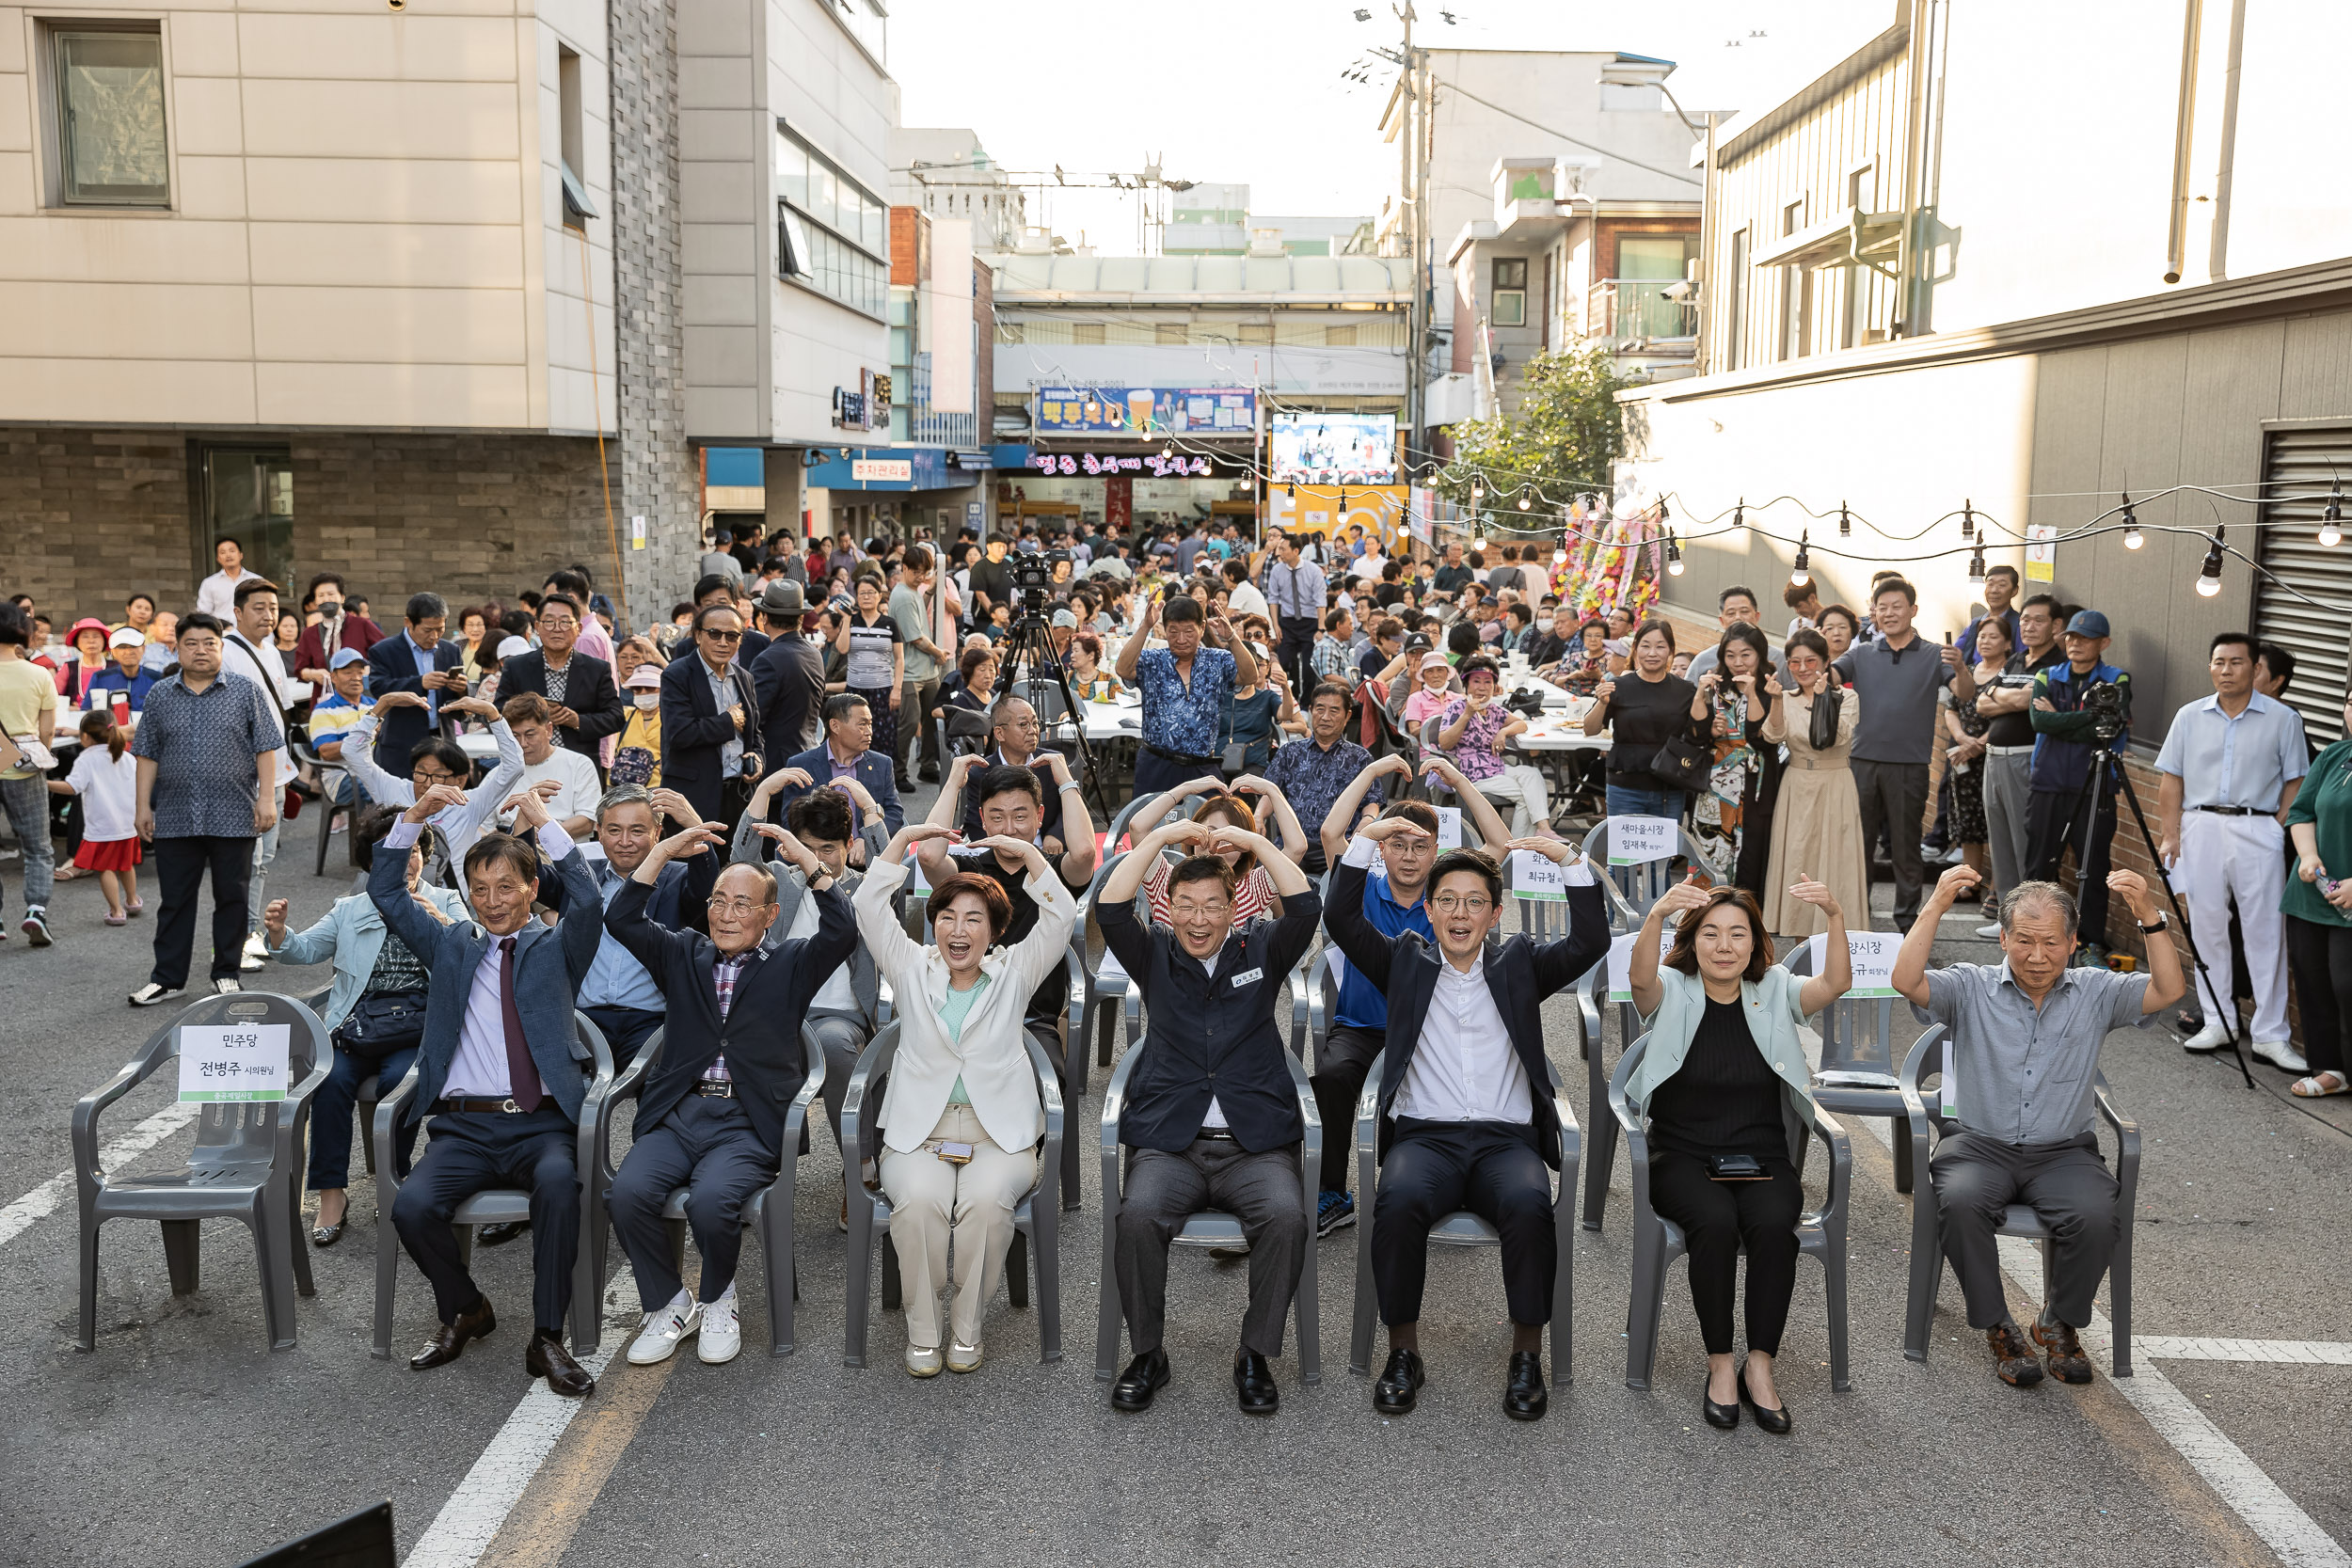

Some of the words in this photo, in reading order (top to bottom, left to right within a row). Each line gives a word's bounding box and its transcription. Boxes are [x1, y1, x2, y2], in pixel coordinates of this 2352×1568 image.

[1621, 823, 1664, 835] 새마을시장
[1622, 839, 1648, 850] 임재복
[1528, 871, 1555, 883] 최규철
[1848, 941, 1883, 955] 양시장
[223, 1034, 258, 1048] 민주당
[199, 1061, 242, 1077] 전병주
[245, 1066, 275, 1075] 시의원님
